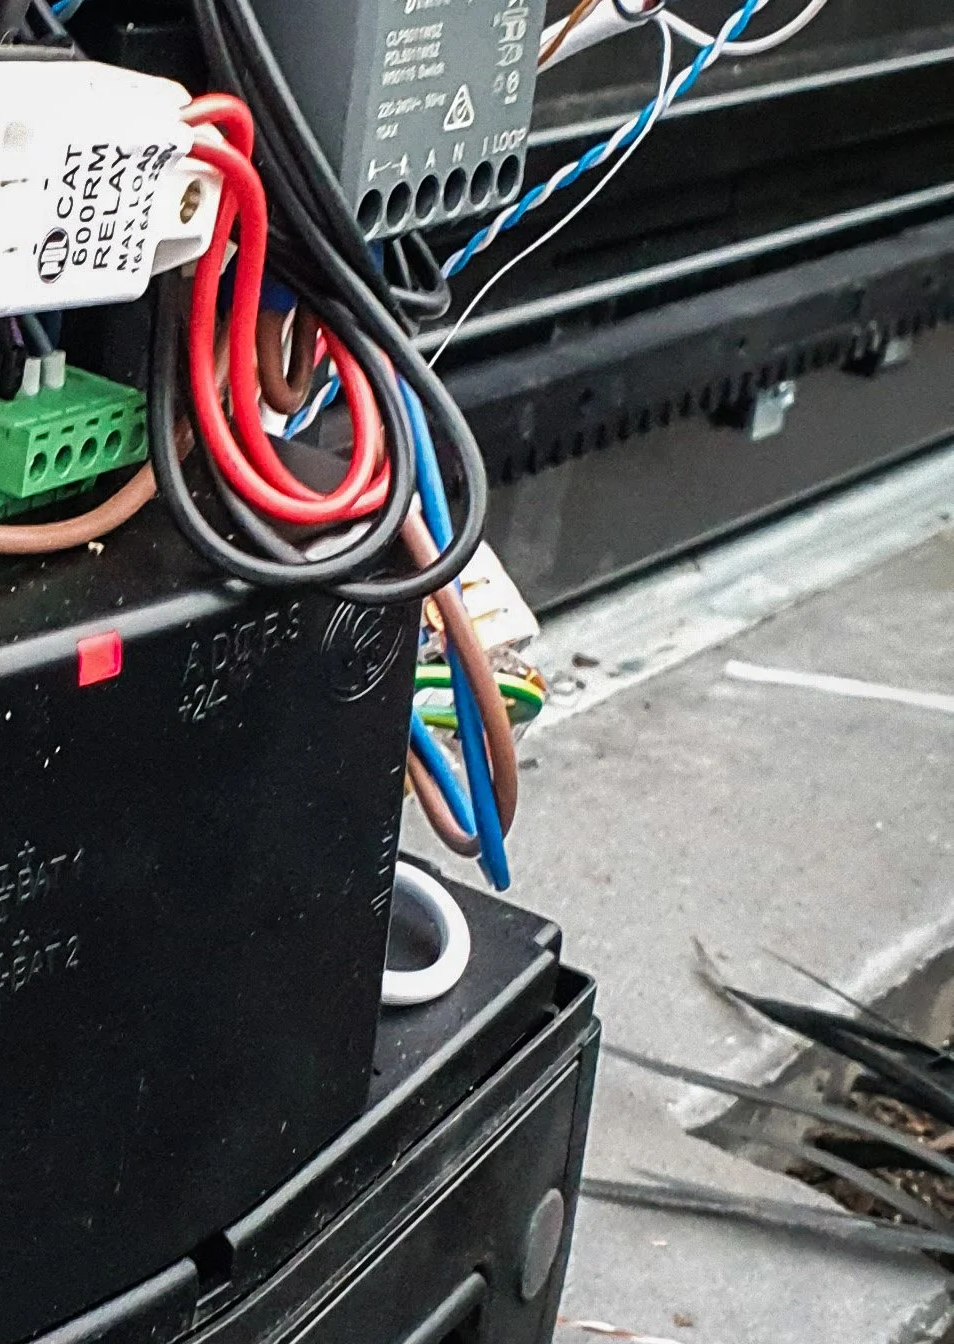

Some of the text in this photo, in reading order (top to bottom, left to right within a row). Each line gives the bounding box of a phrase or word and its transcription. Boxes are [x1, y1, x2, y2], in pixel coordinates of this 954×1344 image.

[56, 144, 82, 219] CAT
[71, 143, 109, 266] 600RM
[92, 145, 131, 270] RELAY
[129, 144, 159, 208] LOAD
